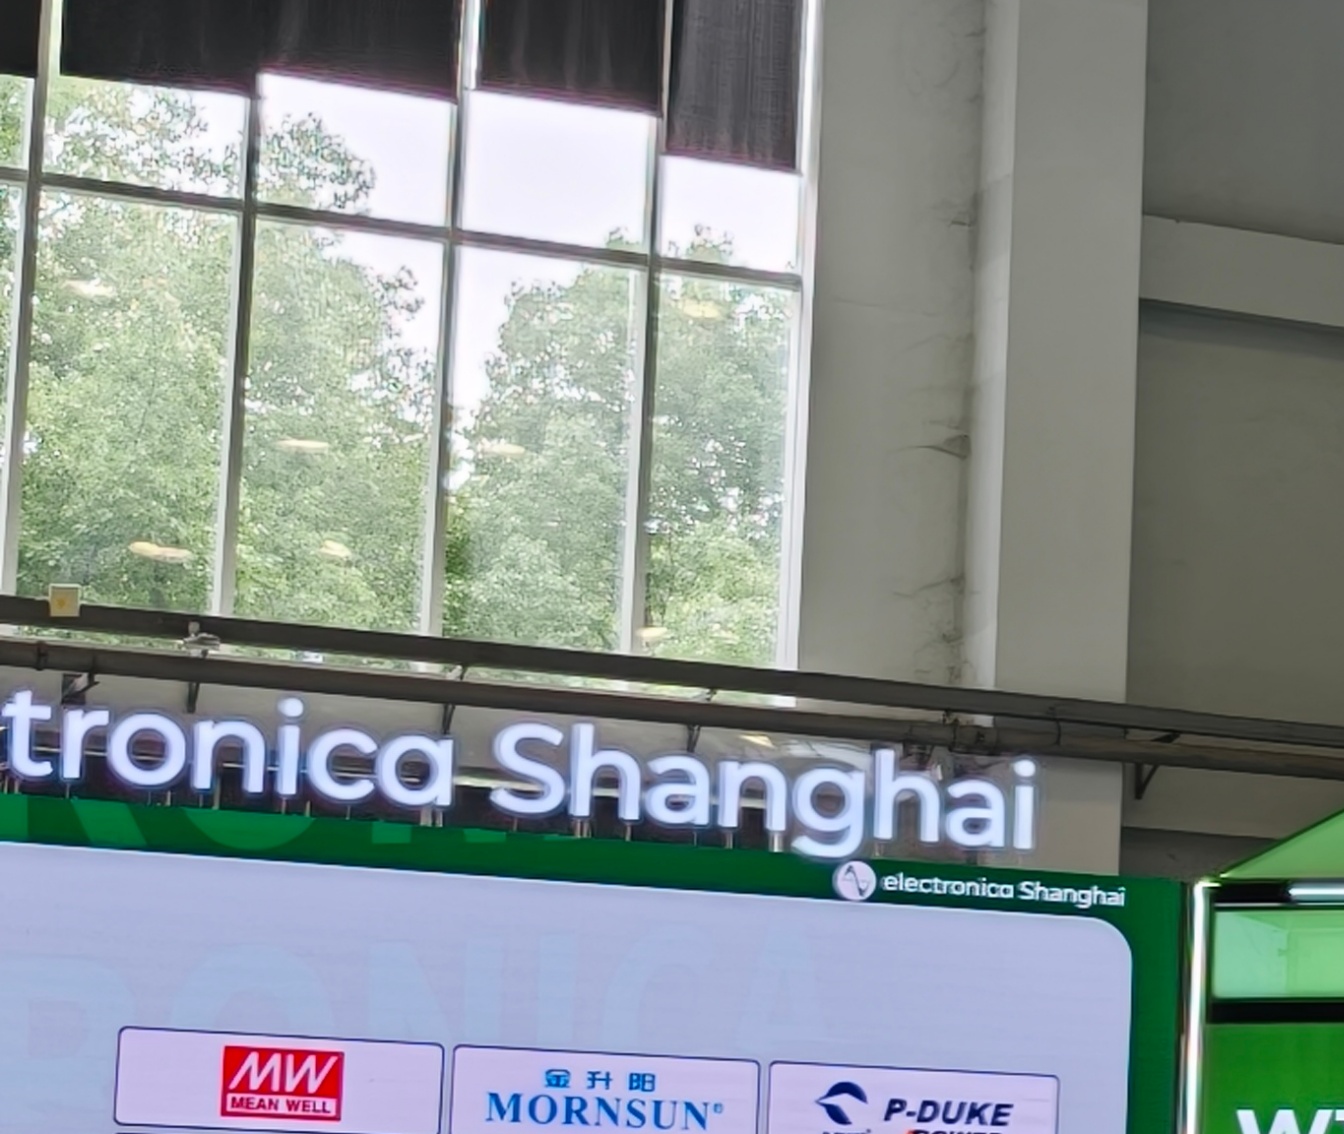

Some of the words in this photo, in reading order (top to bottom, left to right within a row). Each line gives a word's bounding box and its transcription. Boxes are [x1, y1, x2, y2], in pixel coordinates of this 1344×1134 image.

[2, 690, 455, 807] tronica
[490, 722, 1037, 857] Shanghai
[882, 872, 1014, 899] electronica
[1018, 880, 1127, 909] Shanghai
[545, 1069, 656, 1092] 金升阳
[230, 1096, 280, 1112] MEAN
[285, 1098, 332, 1115] WELL
[485, 1092, 709, 1131] MORNSUN
[884, 1098, 1014, 1127] P-DUKE
